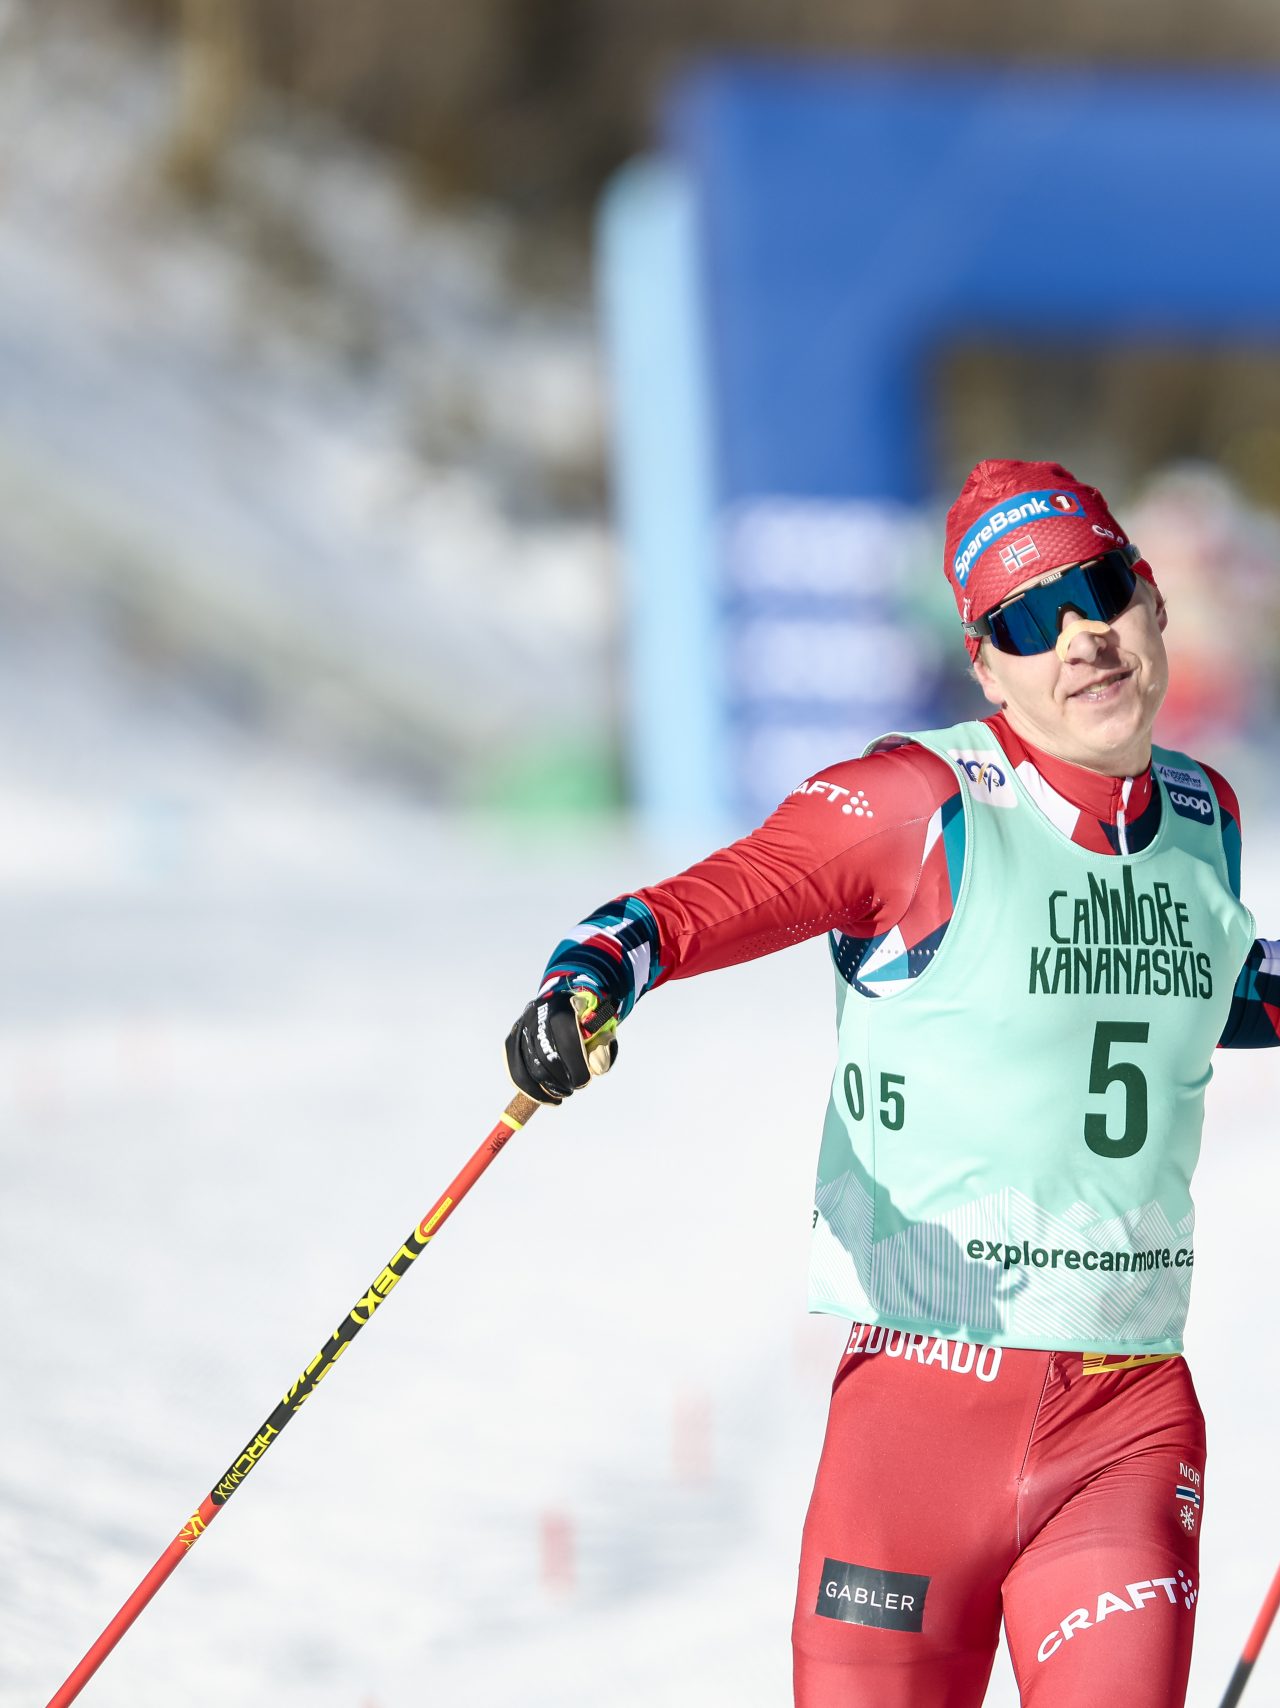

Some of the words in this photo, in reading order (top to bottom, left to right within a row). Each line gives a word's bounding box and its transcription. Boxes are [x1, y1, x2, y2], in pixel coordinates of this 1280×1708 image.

[955, 497, 1050, 580] SpareBank
[1056, 495, 1071, 511] 1
[788, 780, 850, 804] AFT
[1170, 791, 1212, 815] coop
[1029, 946, 1213, 1000] KANANASKIS
[1083, 1020, 1150, 1159] 5
[966, 1239, 1194, 1273] explorecanmore.ca
[351, 1244, 417, 1325] LEKI
[1179, 1461, 1201, 1488] NOR
[825, 1581, 915, 1612] GABLER
[1037, 1577, 1177, 1663] CRAFT
